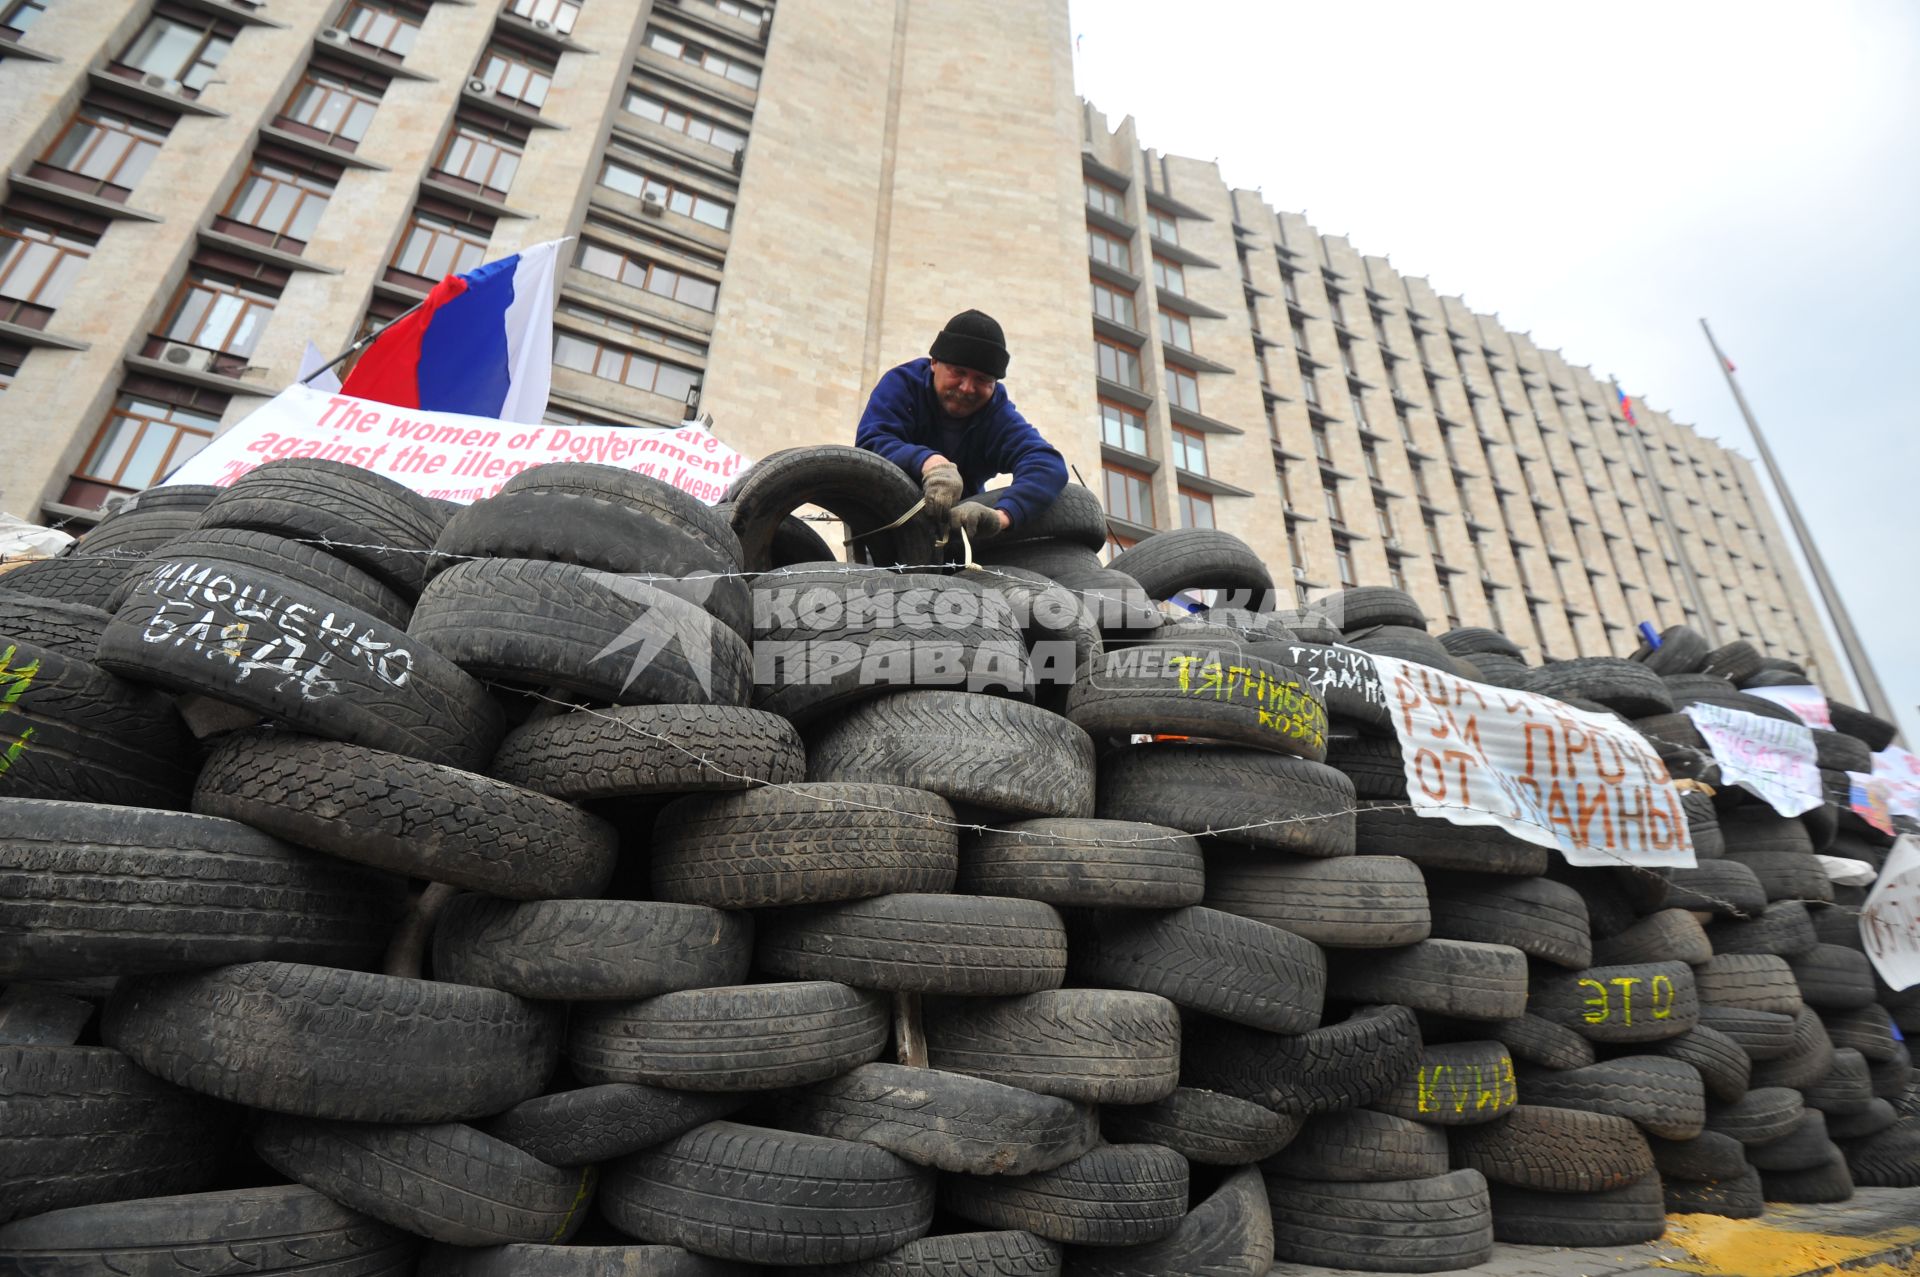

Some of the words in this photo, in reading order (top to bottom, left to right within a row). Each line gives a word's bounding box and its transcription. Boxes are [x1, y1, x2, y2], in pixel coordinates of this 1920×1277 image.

[316, 397, 380, 433] The
[387, 417, 501, 448] women
[507, 428, 545, 450] of
[676, 429, 719, 453] are
[247, 432, 389, 469] against
[388, 445, 447, 475] the
[1414, 748, 1478, 806] ОТ
[1579, 975, 1674, 1026] ЭТО
